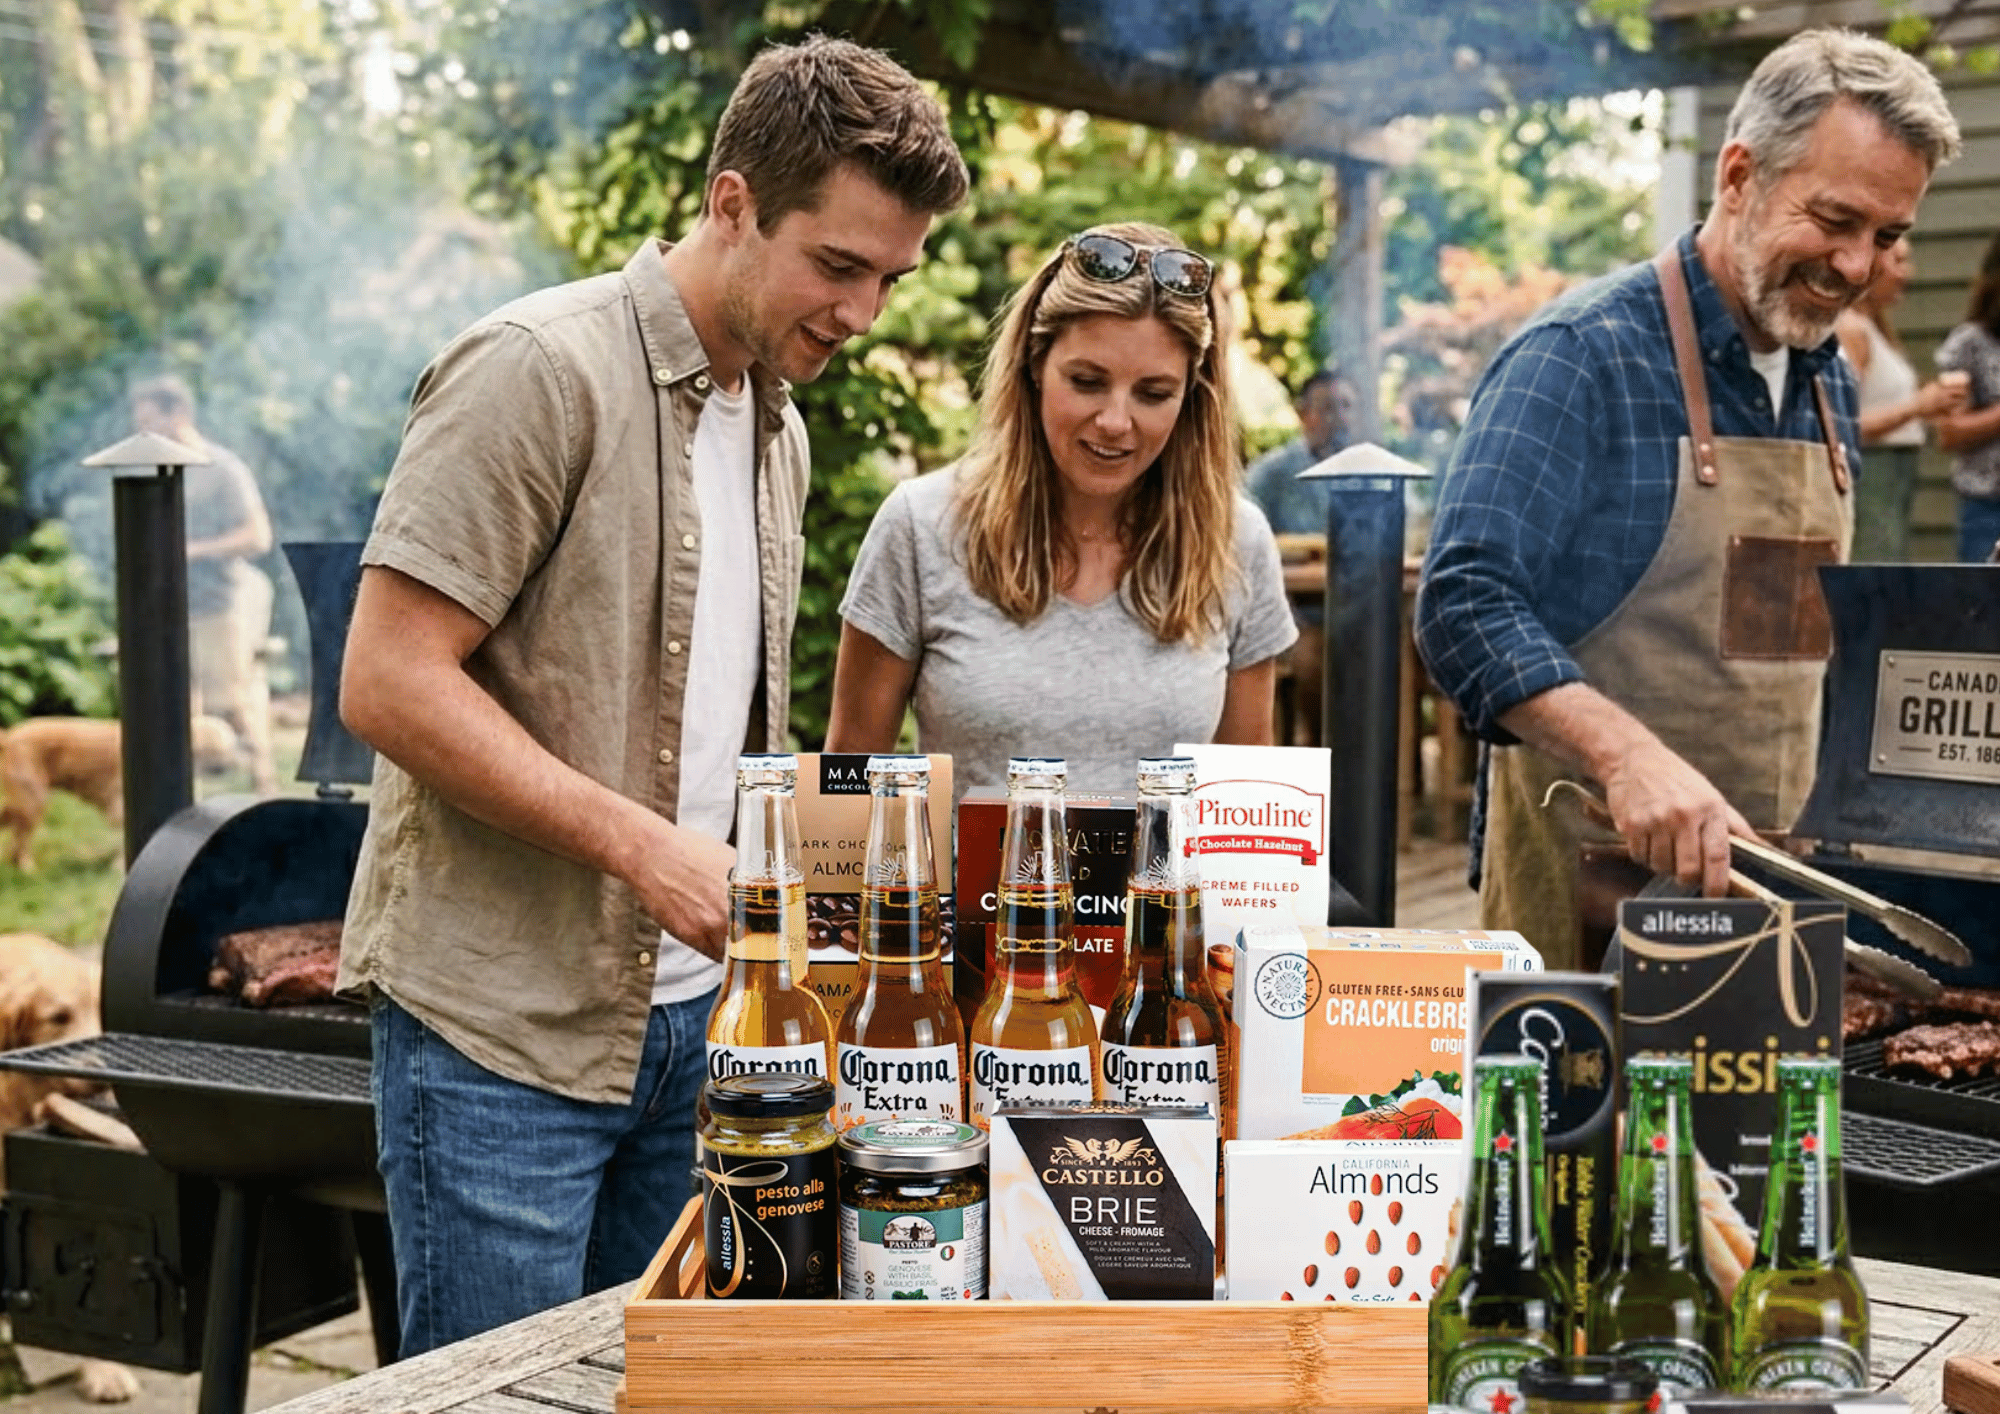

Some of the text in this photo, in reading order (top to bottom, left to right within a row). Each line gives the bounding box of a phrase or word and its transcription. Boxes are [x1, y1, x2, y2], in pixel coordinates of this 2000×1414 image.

[1929, 671, 2000, 693] CANAD
[1939, 743, 1970, 762] EST.
[1198, 800, 1312, 827] Pirouline
[1200, 838, 1303, 852] Chocolate Hazelnut
[1202, 881, 1300, 893] CREME FILLED
[1222, 898, 1277, 909] WAFERS
[1641, 911, 1734, 934] allessia
[1262, 960, 1314, 985] NATURAL
[1263, 990, 1315, 1012] NECTAR
[1328, 984, 1372, 995] GLUTEN
[1442, 986, 1465, 998] GLU
[840, 1049, 951, 1092] Corona
[973, 1049, 1083, 1092] Corona
[1102, 1049, 1211, 1092] Corona
[864, 1087, 929, 1112] Extra
[1343, 1159, 1410, 1169] CALIFORNIA
[1042, 1168, 1164, 1186] CASTELLO
[756, 1178, 825, 1202] pesto alla
[757, 1198, 825, 1221] genovese
[1071, 1196, 1157, 1224] BRIE
[1494, 1158, 1512, 1246] Heineken
[1650, 1159, 1668, 1247] Heineken
[1799, 1159, 1816, 1247] Heineken
[720, 1215, 732, 1271] allessia
[1079, 1226, 1165, 1237] CHEESE FROMAGE
